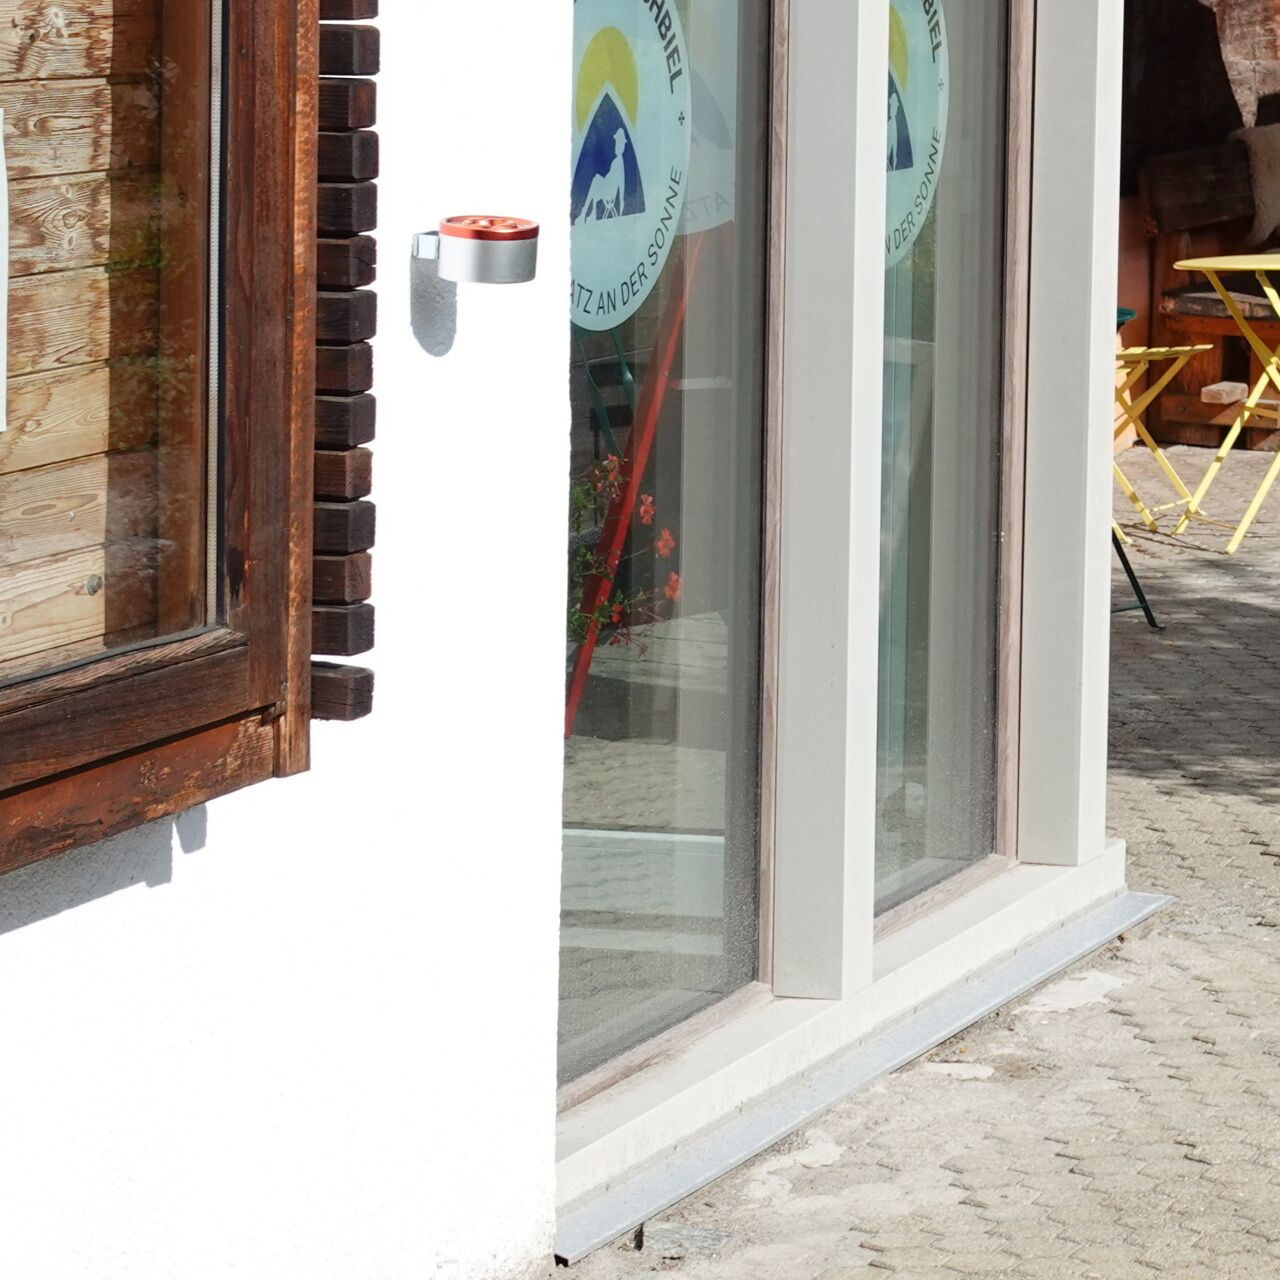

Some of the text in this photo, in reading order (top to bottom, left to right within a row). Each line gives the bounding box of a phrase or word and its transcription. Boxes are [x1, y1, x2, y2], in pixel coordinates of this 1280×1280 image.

[596, 287, 616, 316] AN
[620, 262, 648, 306] DER
[647, 166, 682, 266] SONNE
[894, 211, 915, 250] DER
[914, 126, 942, 215] SONNE
